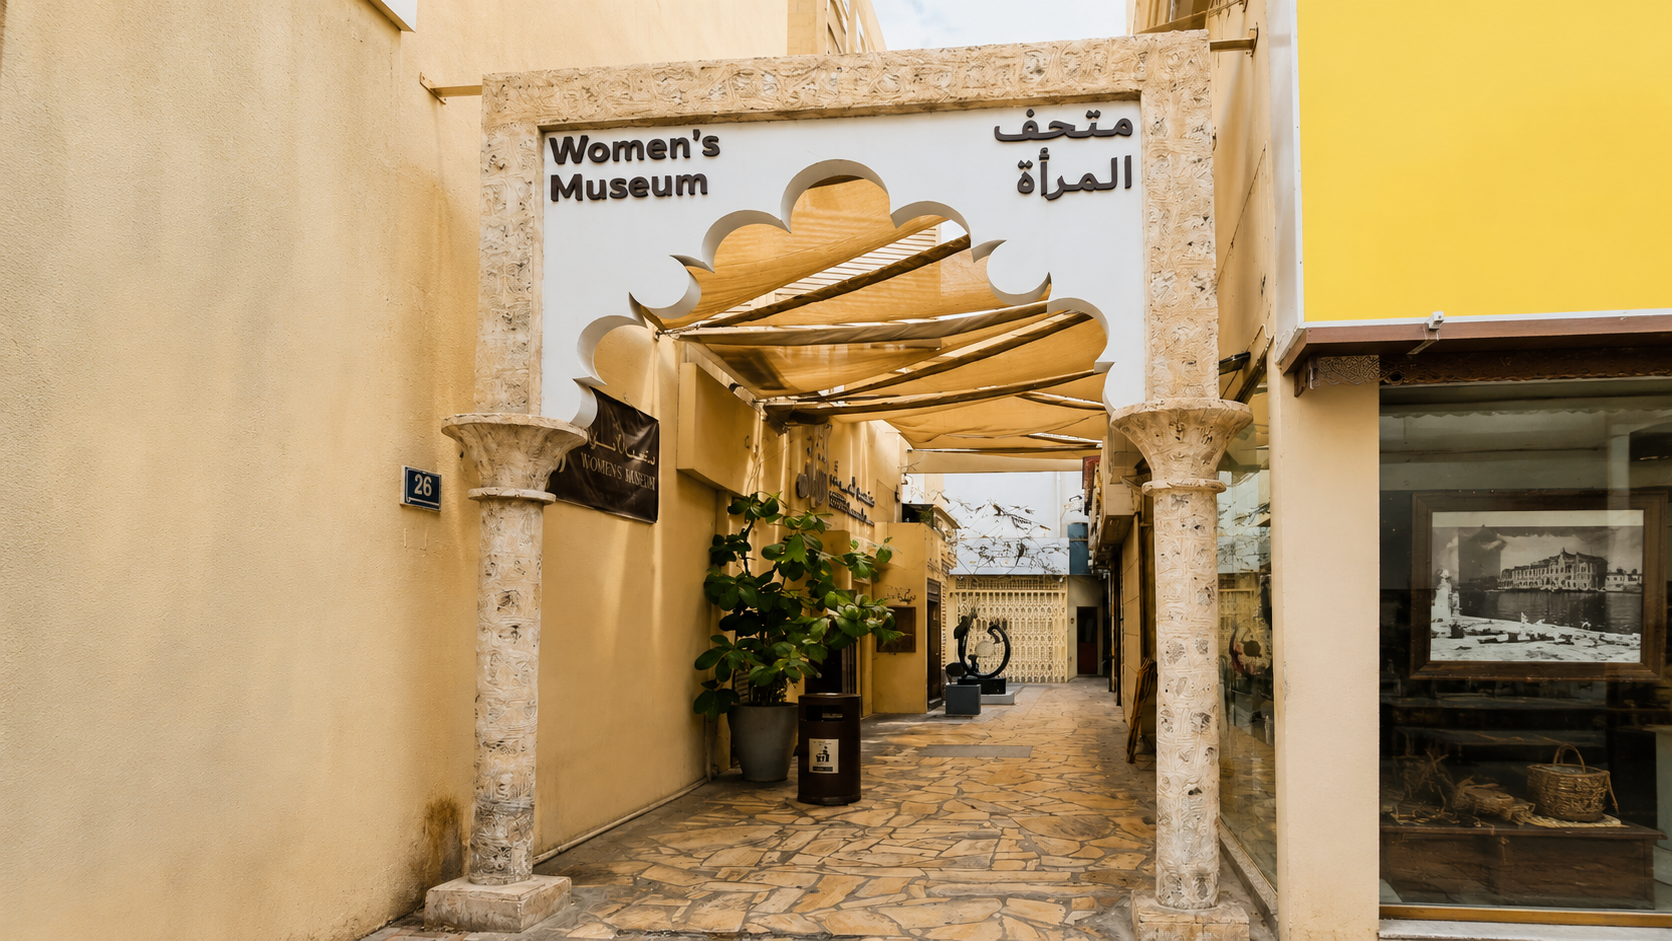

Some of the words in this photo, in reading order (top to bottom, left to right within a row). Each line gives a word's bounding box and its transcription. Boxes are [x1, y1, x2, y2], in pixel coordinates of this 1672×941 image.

[994, 109, 1133, 142] متحف
[549, 129, 720, 165] Women's
[550, 173, 708, 202] Museum
[1017, 147, 1132, 201] المرأة
[414, 473, 432, 497] 26
